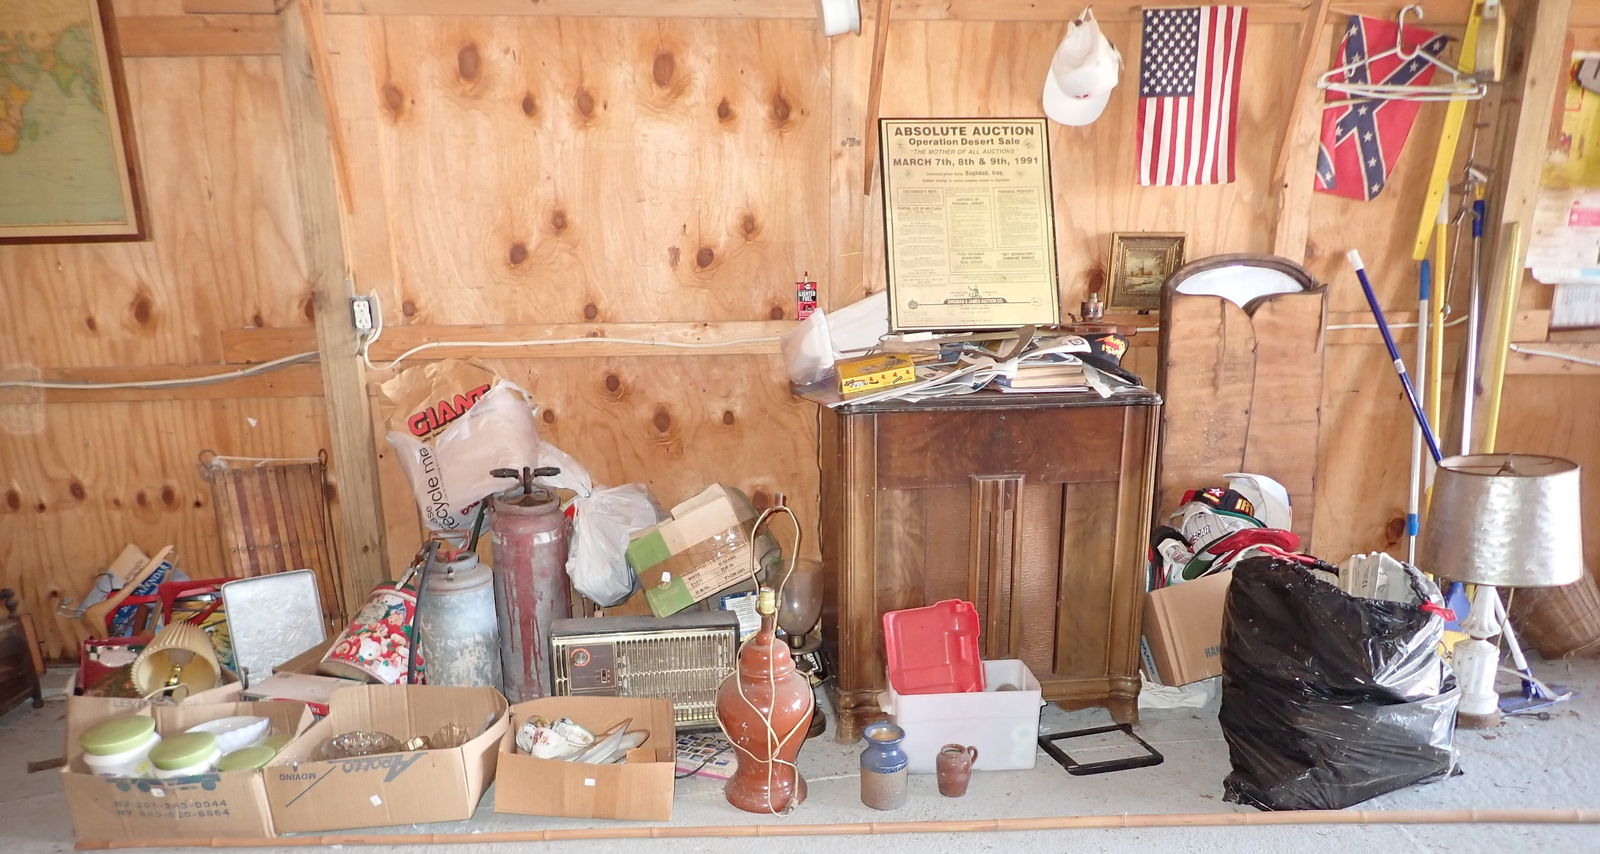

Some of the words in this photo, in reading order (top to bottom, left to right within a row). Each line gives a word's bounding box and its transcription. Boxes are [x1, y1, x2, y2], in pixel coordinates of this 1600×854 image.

[894, 126, 967, 137] ABSOLUTE
[972, 126, 1035, 136] AUCTION
[908, 138, 959, 147] Operation
[961, 137, 995, 146] Desert
[998, 137, 1020, 146] Sale
[893, 158, 932, 167] MARCH
[935, 157, 955, 167] 7th,
[957, 157, 975, 166] 8th
[978, 157, 986, 165] &
[990, 157, 1010, 166] 9th,
[408, 384, 491, 437] GIANT
[419, 447, 434, 474] me
[427, 476, 461, 530] recycle
[279, 772, 316, 781] MOVING
